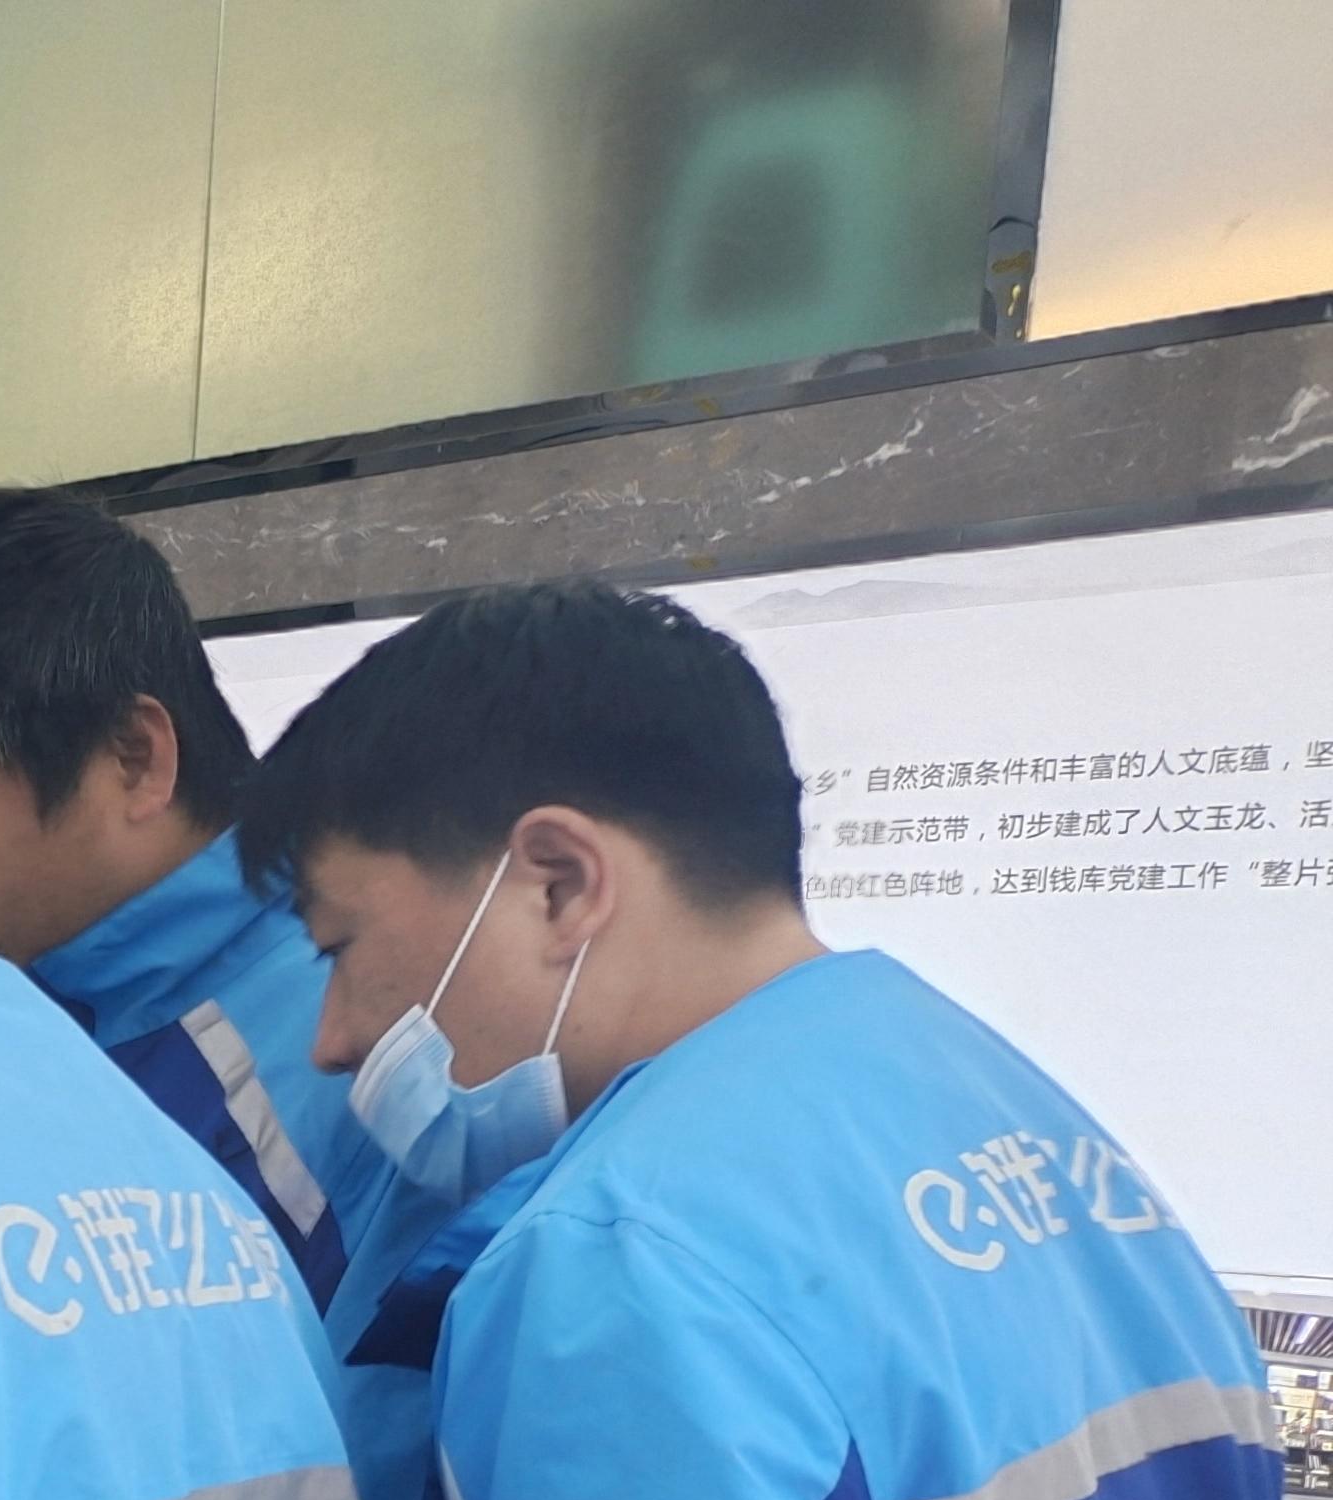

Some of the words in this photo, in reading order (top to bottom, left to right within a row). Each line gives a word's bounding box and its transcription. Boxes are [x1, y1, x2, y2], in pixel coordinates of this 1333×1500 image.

[803, 740, 1333, 796] 乡”自然资源条件和丰富的人文底蕴，坚
[801, 799, 1333, 850] ”党建示范带，初步建成了人文玉龙、活
